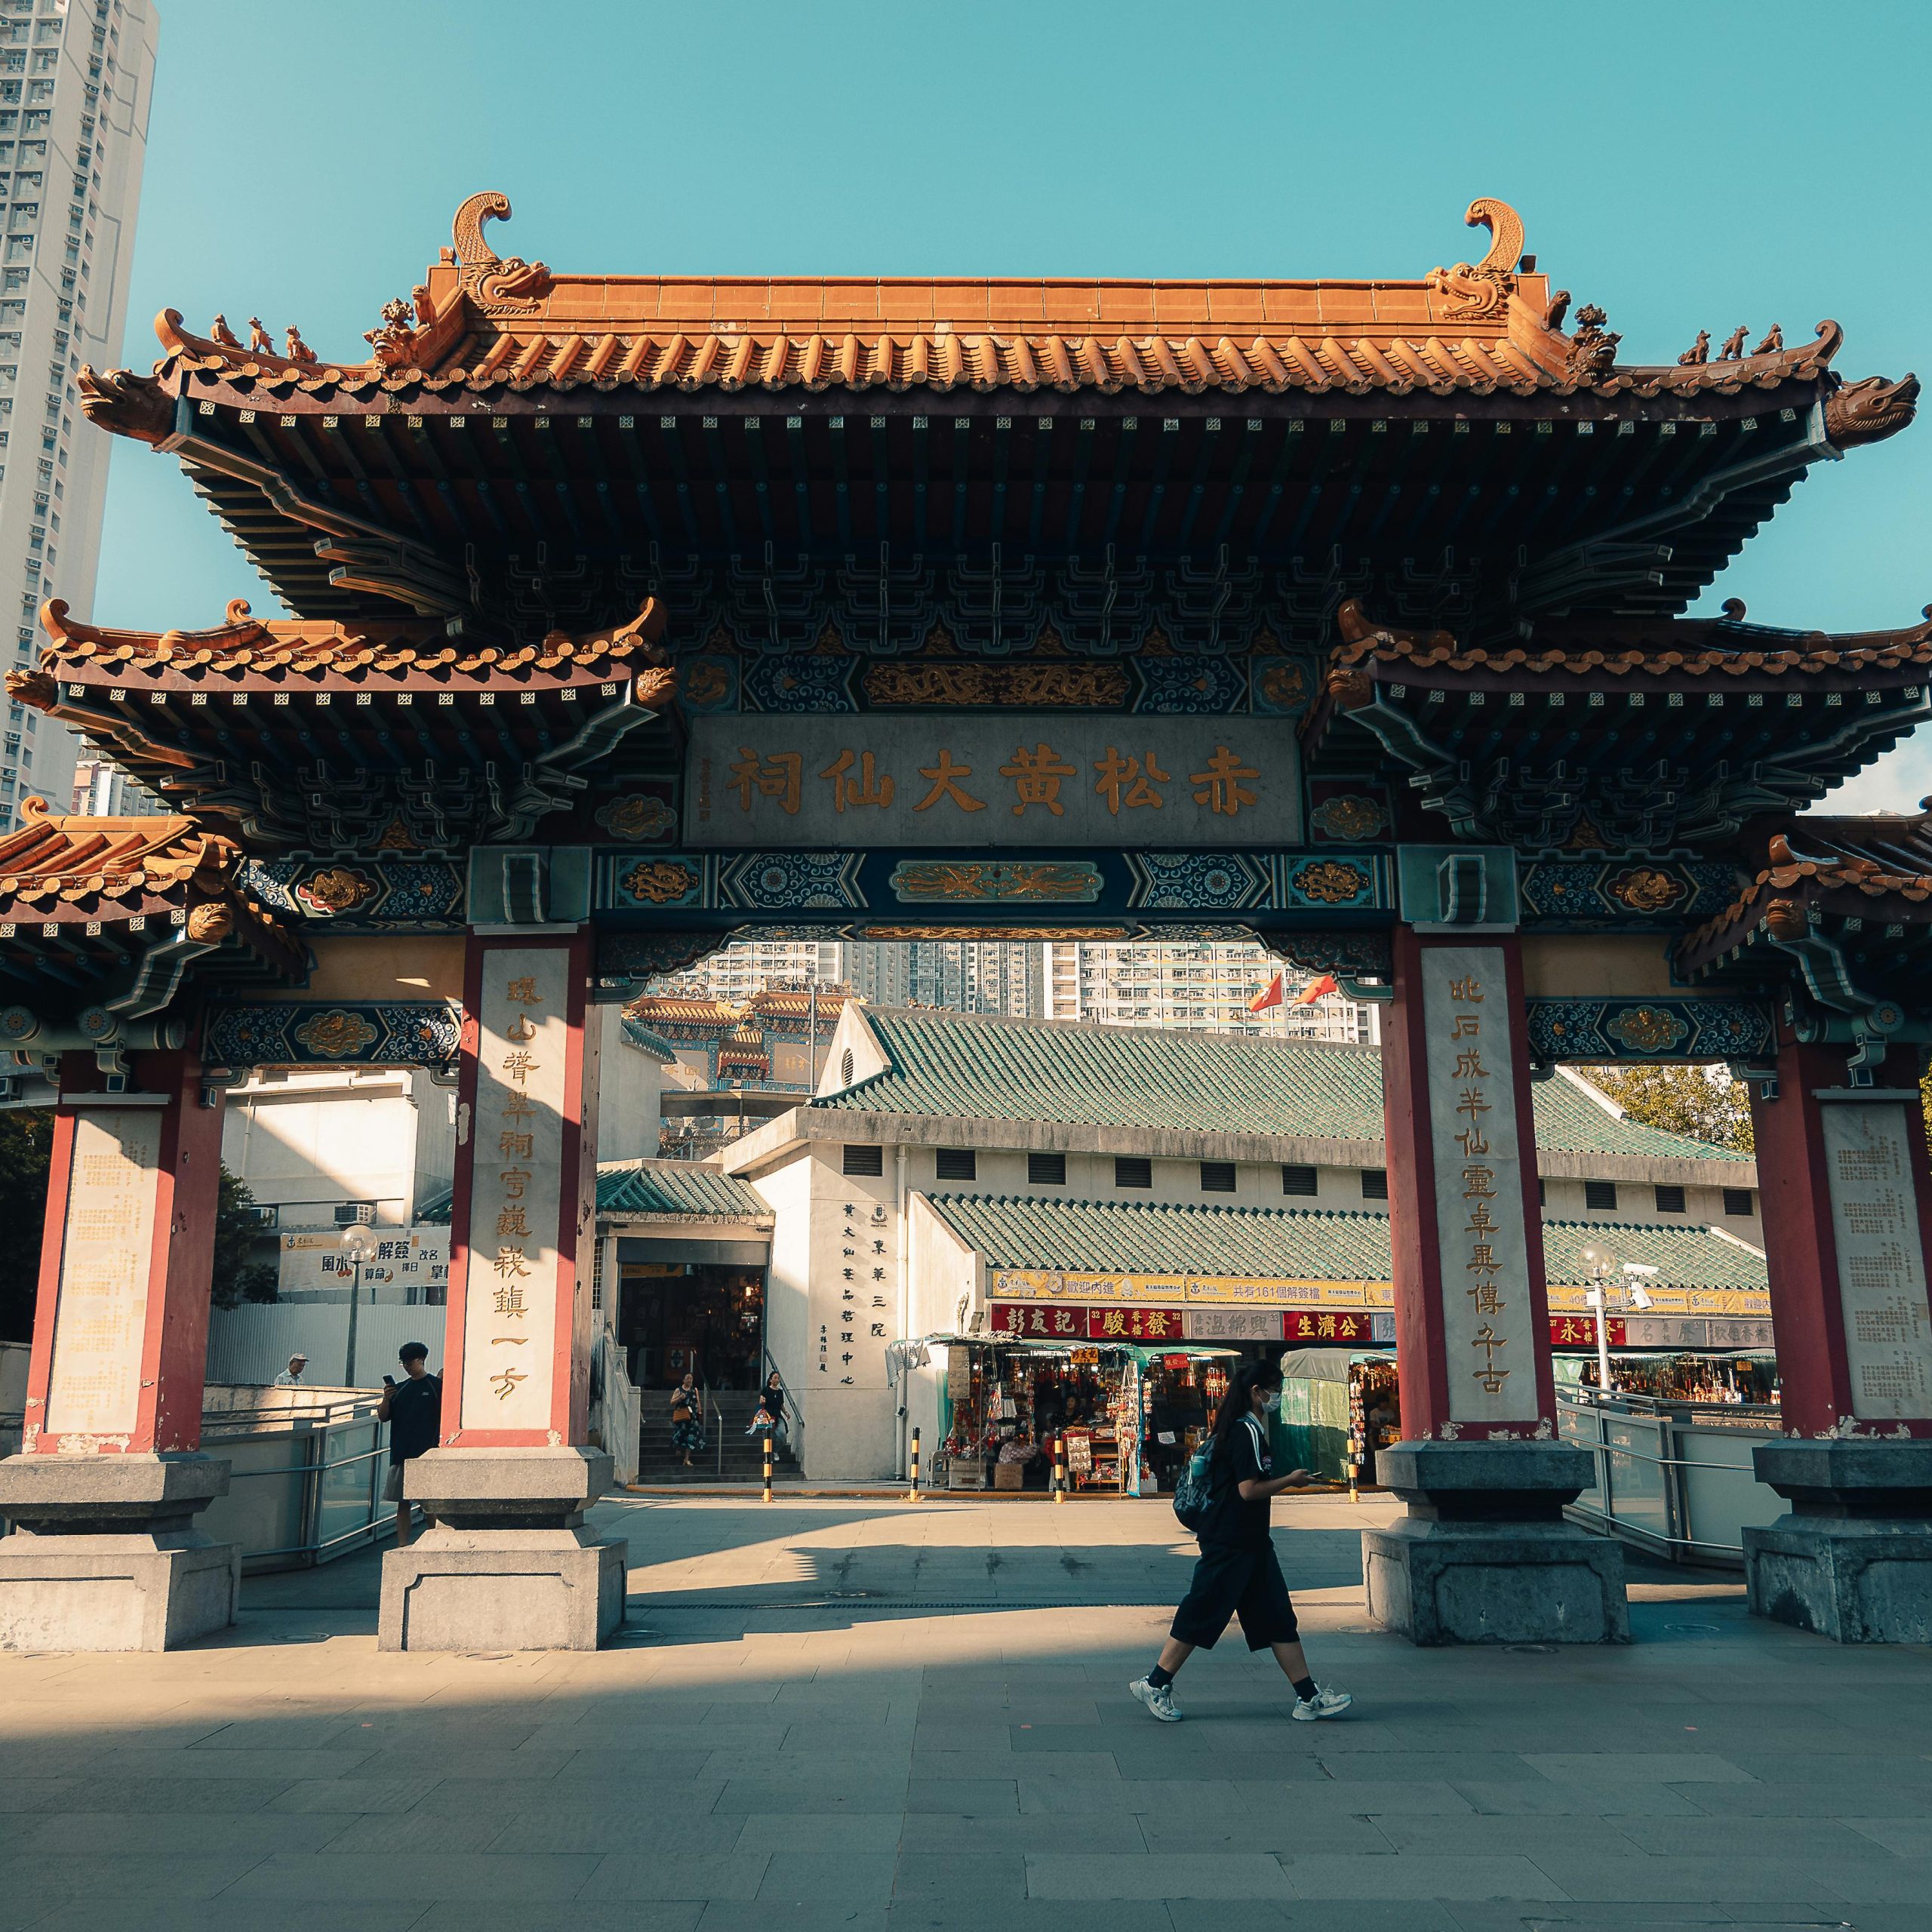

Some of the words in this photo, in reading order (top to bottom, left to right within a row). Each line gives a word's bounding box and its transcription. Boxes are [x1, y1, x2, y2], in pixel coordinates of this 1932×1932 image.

[419, 1249, 438, 1260] 改名
[321, 1255, 349, 1272] 風水
[365, 1267, 385, 1281] 算命
[871, 1239, 887, 1337] 東華三院
[1007, 1307, 1075, 1334] 彭友記
[1091, 1310, 1100, 1319] 32
[1172, 1312, 1181, 1321] 32
[1269, 1313, 1279, 1321] 33
